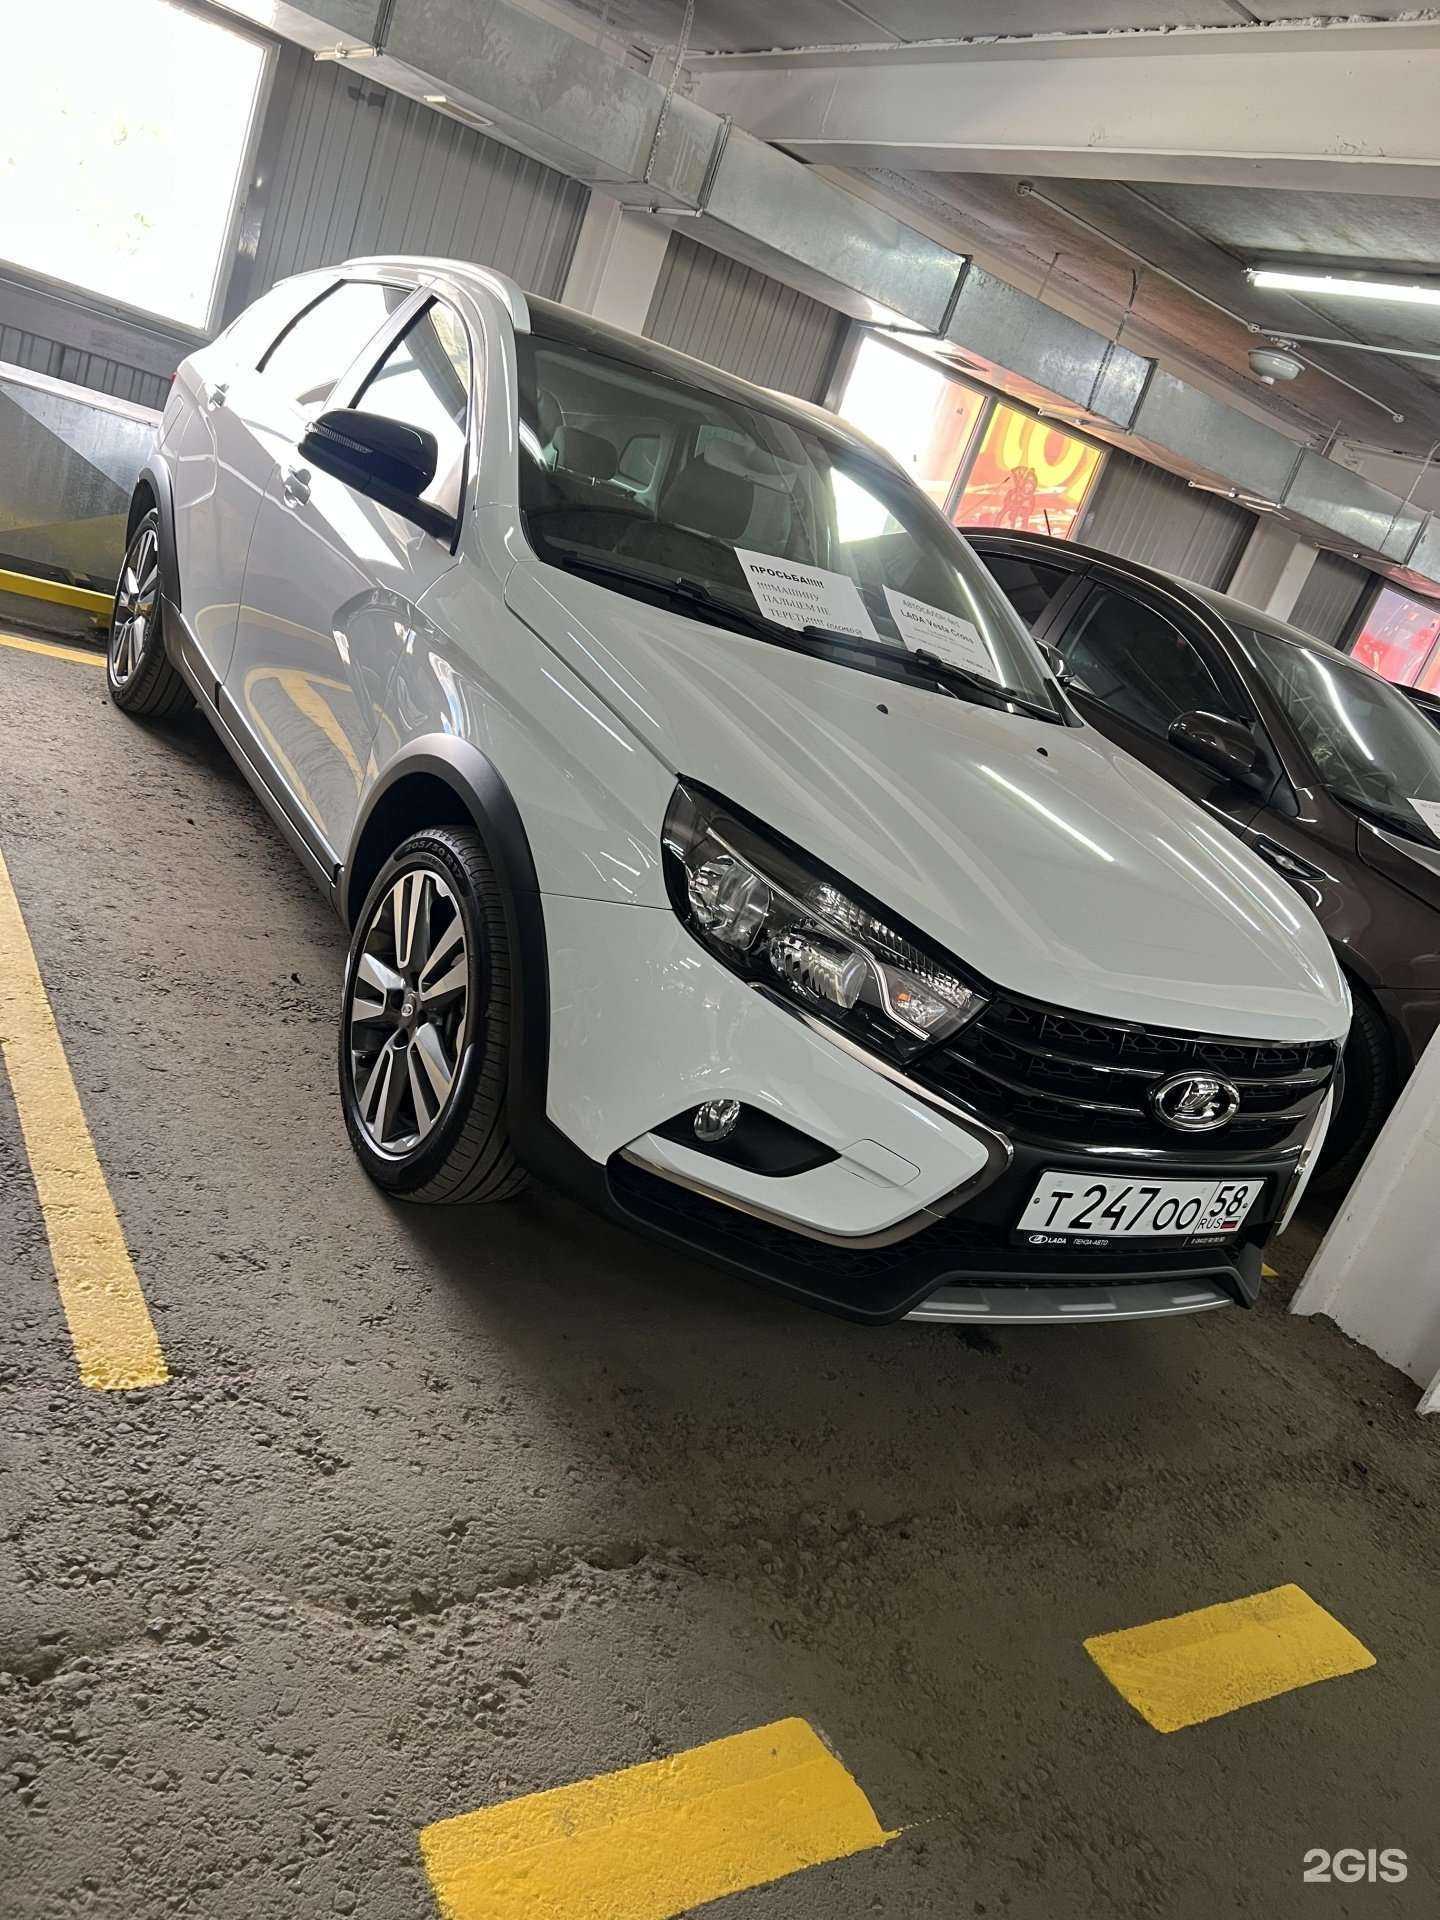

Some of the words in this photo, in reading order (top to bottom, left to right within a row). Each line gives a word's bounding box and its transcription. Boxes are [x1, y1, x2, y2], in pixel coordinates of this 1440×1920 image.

[900, 609, 926, 625] LADA
[1209, 1185, 1249, 1218] 58
[1198, 1217, 1222, 1230] RUS
